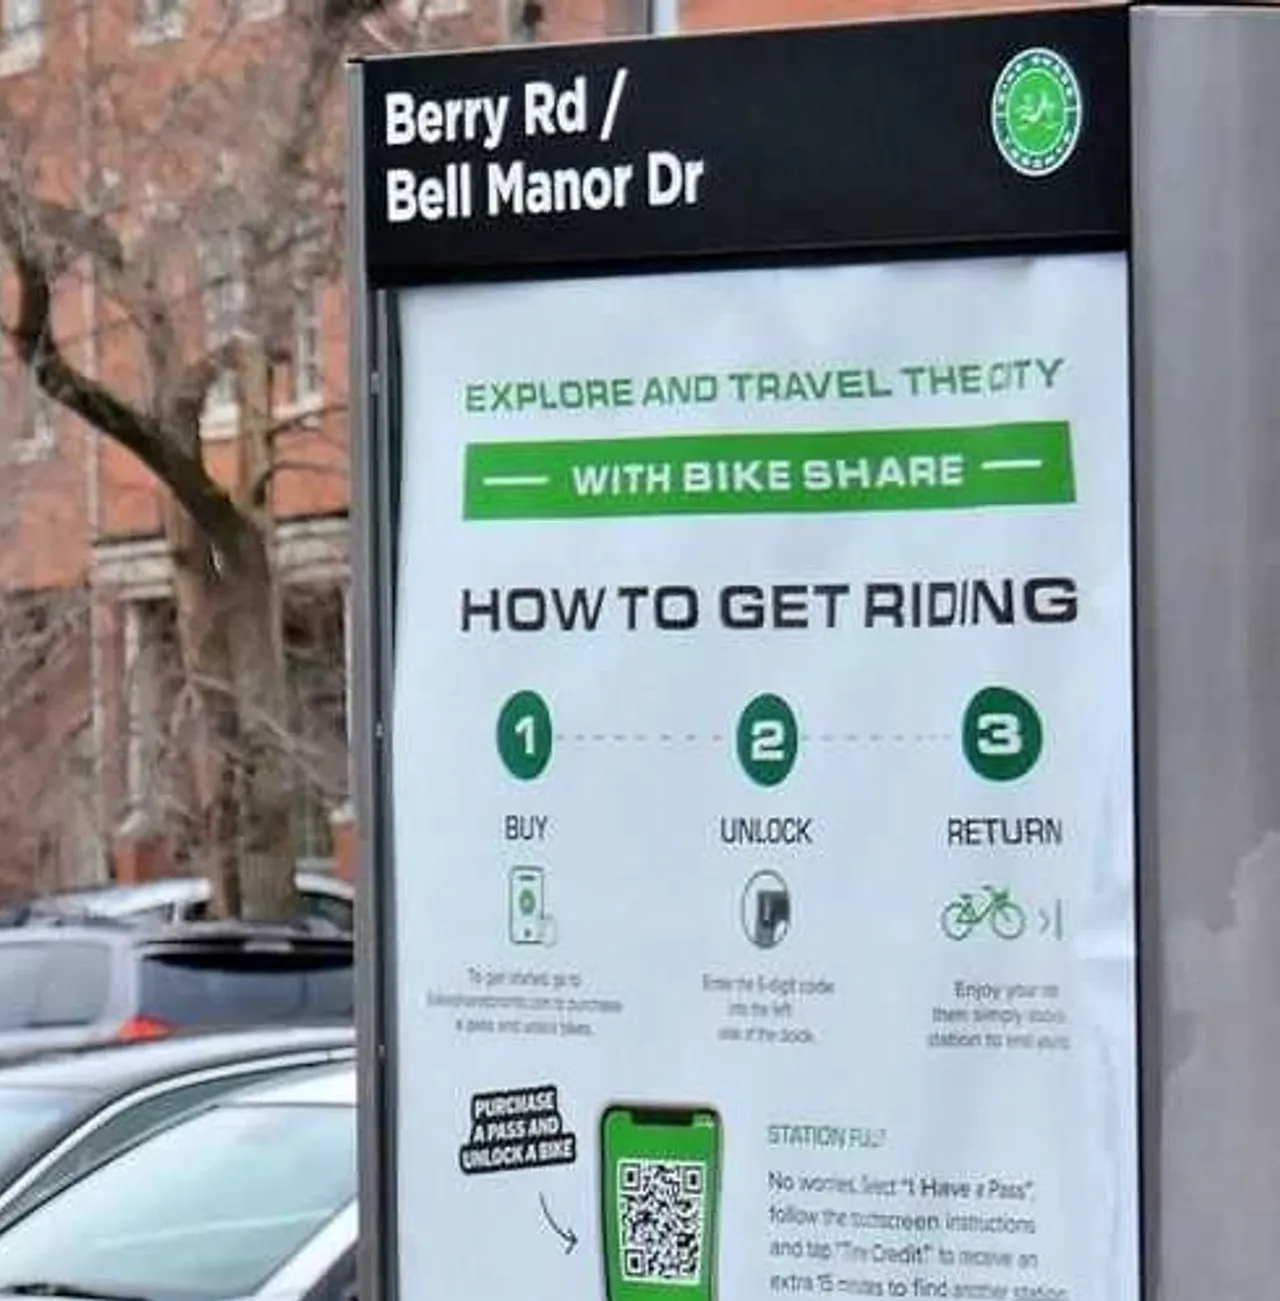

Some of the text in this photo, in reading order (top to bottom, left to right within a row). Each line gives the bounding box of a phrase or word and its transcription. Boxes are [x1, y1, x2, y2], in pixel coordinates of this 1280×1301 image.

[385, 68, 628, 149] Berry Rd /
[386, 151, 704, 222] Bell Manor Dr
[465, 357, 1064, 412] EXPLORE AND TRAVEL THE CITY
[571, 453, 965, 497] WITH BIKE SHARE
[460, 577, 1078, 632] HOW TO GET RIDING
[514, 716, 536, 756] 1
[750, 720, 785, 762] 2
[977, 713, 1024, 756] 3
[505, 815, 548, 841] BUY
[720, 818, 813, 846] UNLOCK
[947, 818, 1064, 847] RETURN
[474, 1090, 555, 1119] PURCHASE
[473, 1115, 560, 1143] A PASS AND
[768, 1124, 845, 1150] STATION
[462, 1138, 574, 1170] UNLOCK A BIKE
[768, 1169, 794, 1193] No
[919, 1177, 971, 1198] Have
[768, 1204, 819, 1226] follow
[769, 1240, 804, 1259] and
[769, 1273, 814, 1293] extra
[888, 1281, 908, 1298] to
[912, 1277, 948, 1298] find
